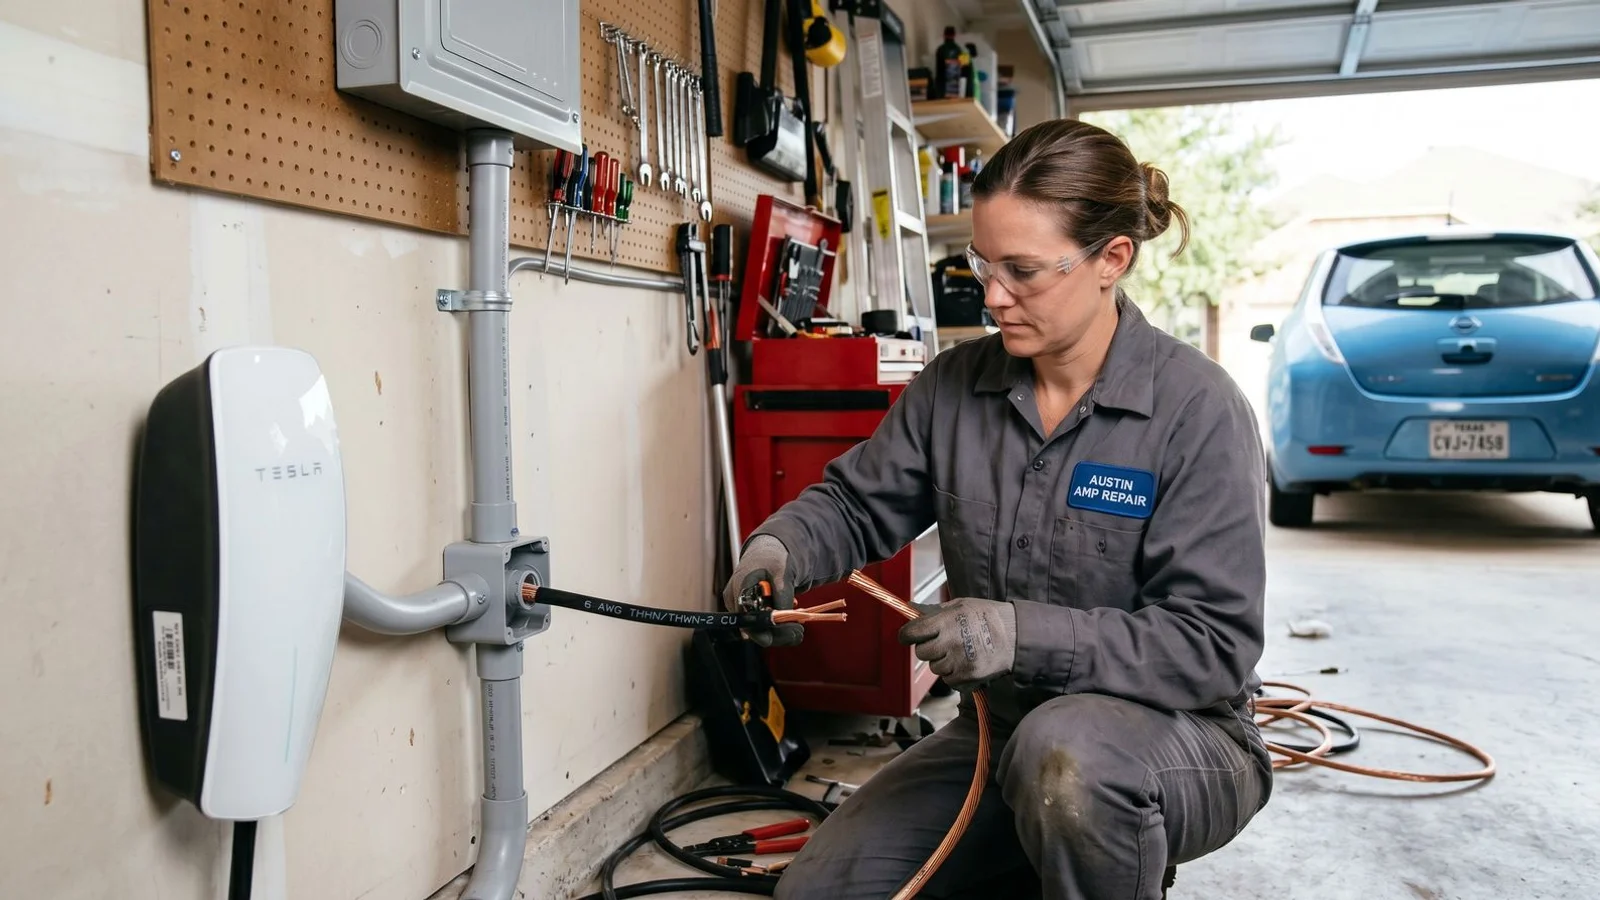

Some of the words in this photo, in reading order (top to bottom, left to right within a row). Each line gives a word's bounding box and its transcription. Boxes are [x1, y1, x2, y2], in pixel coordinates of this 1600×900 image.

[1453, 423, 1485, 432] TEXAS
[254, 462, 322, 482] TESLA
[1089, 475, 1133, 490] AUSTIN
[1074, 486, 1099, 498] AMP
[1101, 490, 1146, 506] REPAIR
[584, 600, 592, 609] 6
[597, 603, 623, 614] AWG
[630, 608, 714, 625] THHN/THWN-2
[720, 615, 737, 625] CU
